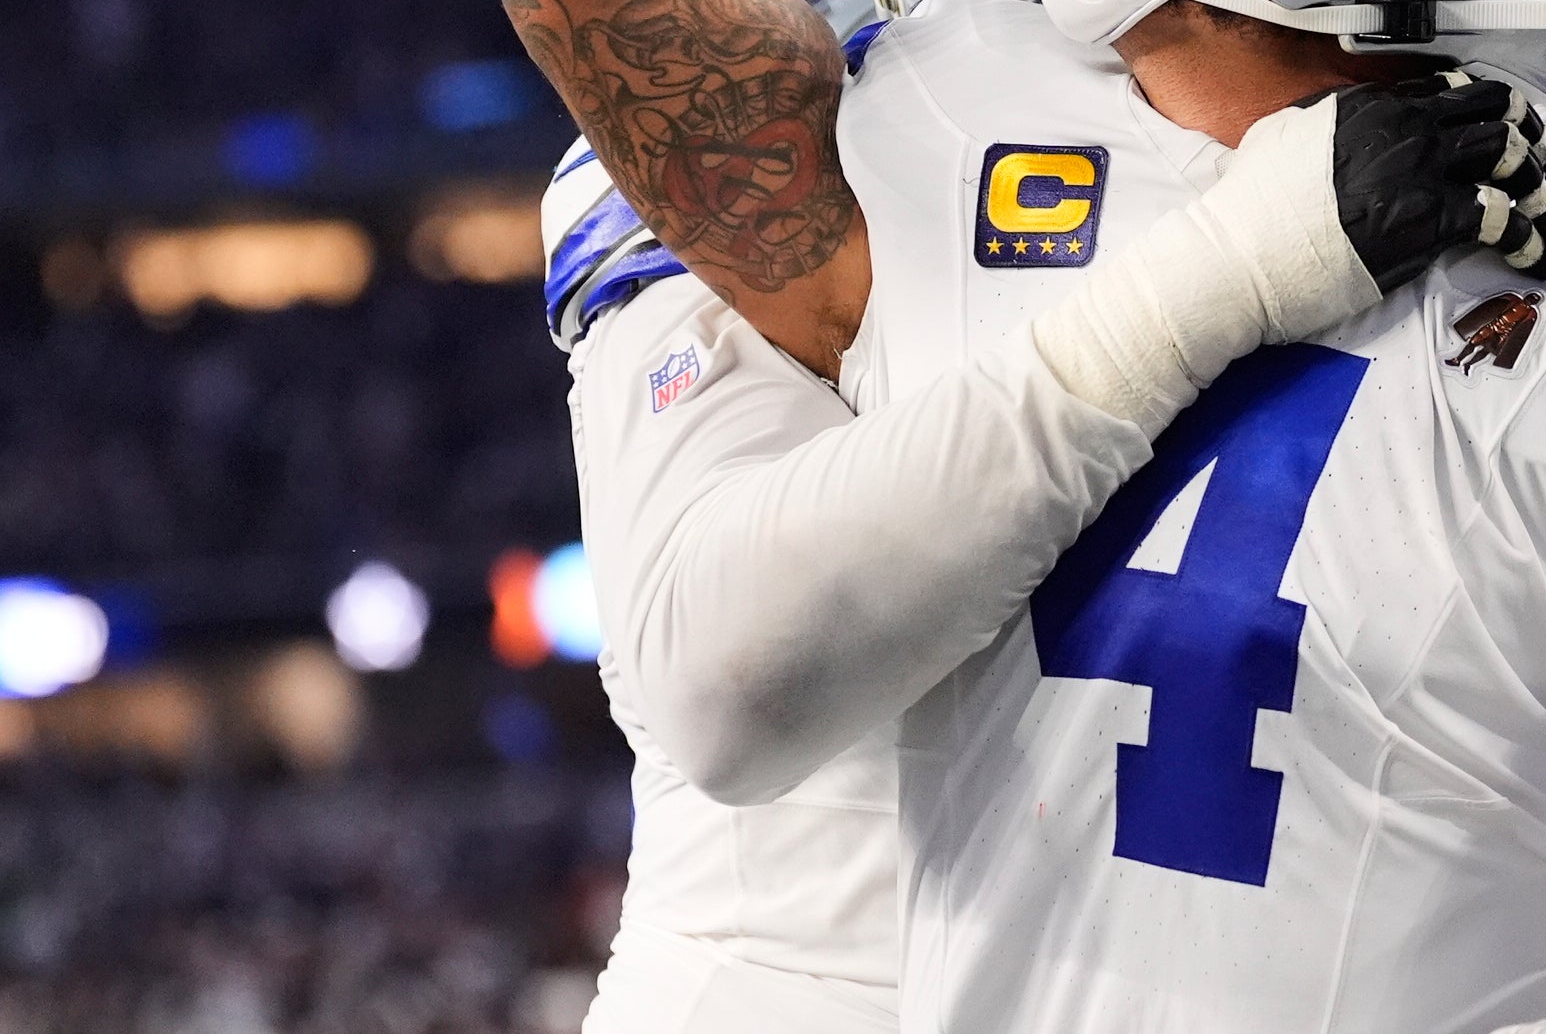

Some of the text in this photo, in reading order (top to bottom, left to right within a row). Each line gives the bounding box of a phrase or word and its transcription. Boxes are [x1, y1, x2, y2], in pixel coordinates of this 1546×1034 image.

[986, 152, 1097, 234] C
[656, 370, 692, 409] NFL
[1029, 340, 1372, 888] 4
